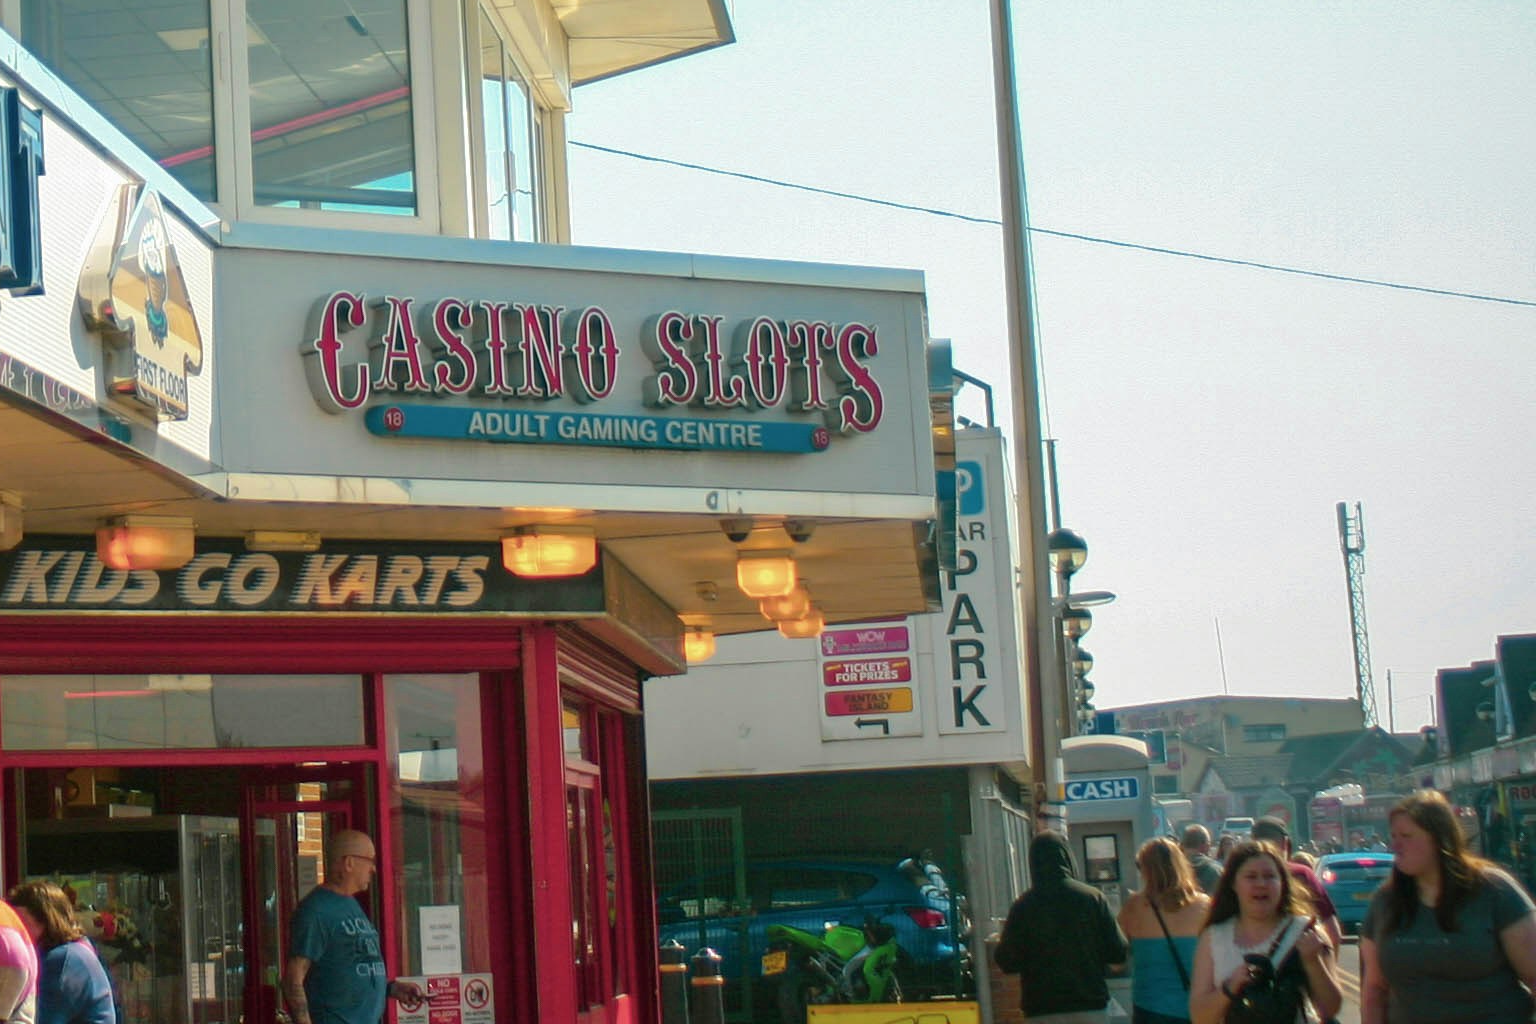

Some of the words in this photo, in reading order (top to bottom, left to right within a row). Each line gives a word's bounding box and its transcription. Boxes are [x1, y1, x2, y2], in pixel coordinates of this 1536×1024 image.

[310, 290, 621, 411] CASINO
[654, 310, 884, 434] SLOTS
[159, 366, 186, 404] FLOOR
[383, 411, 404, 428] 18
[468, 412, 550, 438] ADULT
[558, 416, 658, 443] GAMING
[665, 421, 763, 448] CENTRE
[176, 552, 280, 606] GO
[289, 554, 490, 607] KARTS
[856, 630, 886, 642] WOW
[945, 548, 992, 728] PARK
[835, 672, 858, 683] FOR
[860, 670, 899, 681] PRIZES
[843, 661, 890, 673] TICKETS
[844, 692, 893, 703] FANTASY
[1066, 779, 1130, 800] CASH
